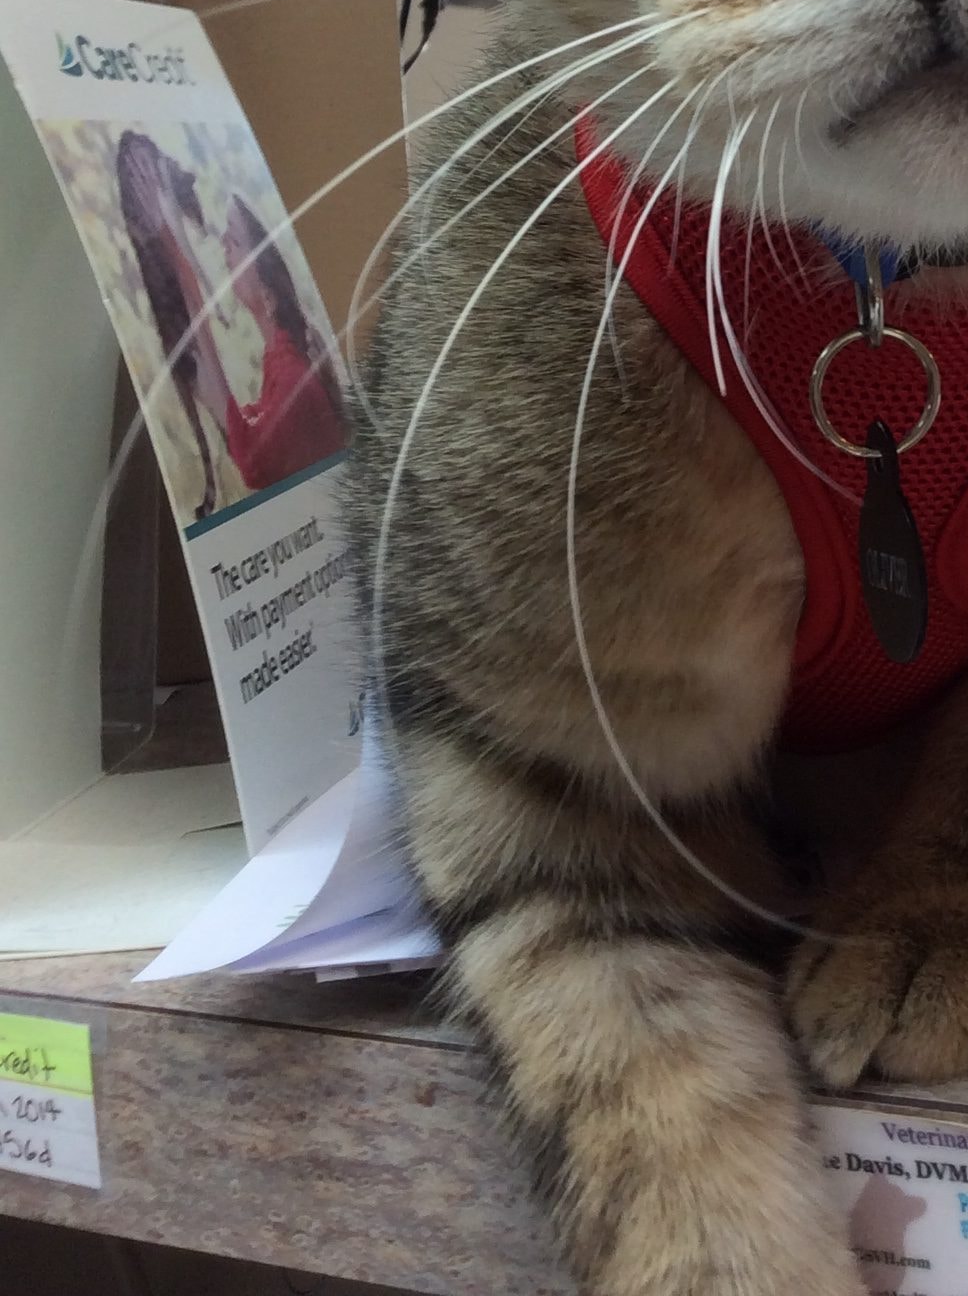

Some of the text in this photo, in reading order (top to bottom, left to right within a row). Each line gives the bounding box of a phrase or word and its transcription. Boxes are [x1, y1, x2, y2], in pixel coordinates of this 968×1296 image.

[210, 562, 242, 601] The
[241, 550, 269, 585] care
[267, 540, 293, 579] you
[224, 602, 262, 651] With
[261, 571, 316, 640] payment
[240, 650, 280, 704] made
[845, 1152, 911, 1182] Davis,
